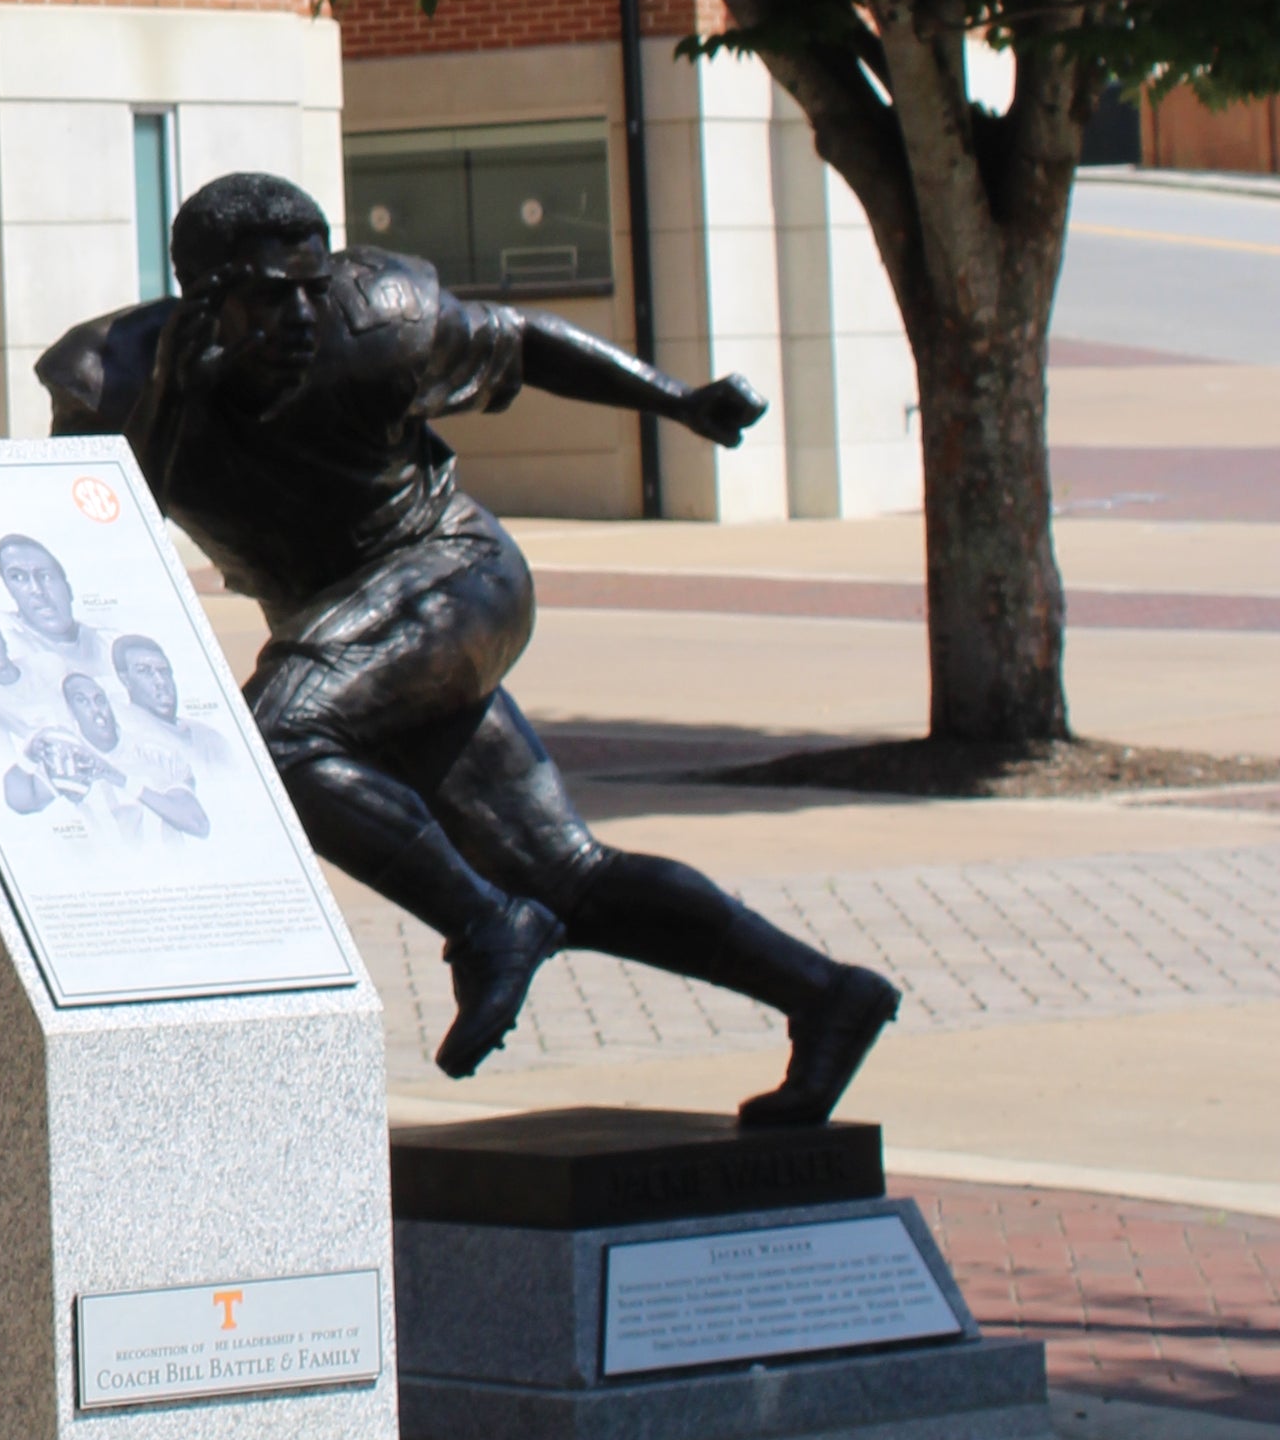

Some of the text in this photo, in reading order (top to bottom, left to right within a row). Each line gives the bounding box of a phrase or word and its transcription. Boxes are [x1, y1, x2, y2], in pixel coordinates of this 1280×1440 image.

[213, 1289, 243, 1331] T
[116, 1326, 360, 1363] RECOGNITION OF HE LEADERSHIP SPPORT OF
[96, 1346, 362, 1391] COACH BILL BATTLE & FAMILY
